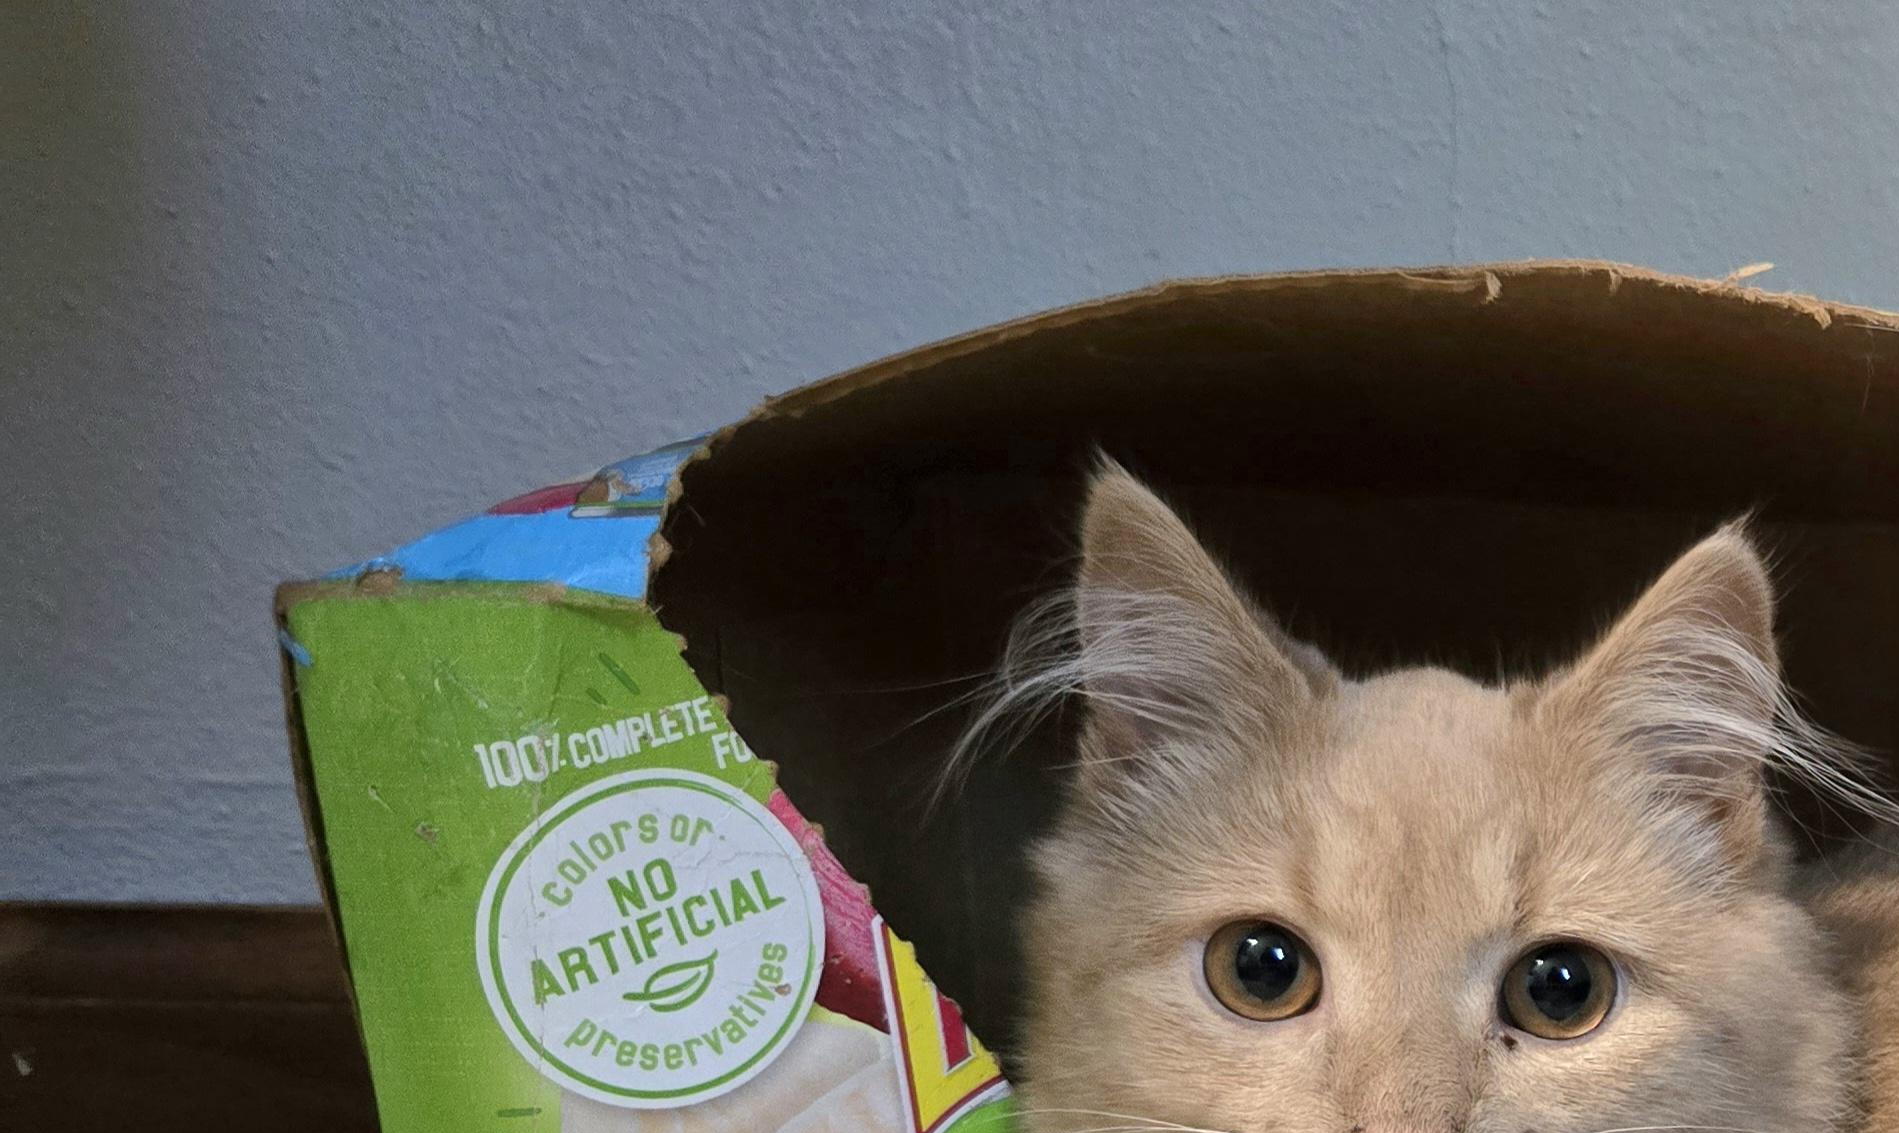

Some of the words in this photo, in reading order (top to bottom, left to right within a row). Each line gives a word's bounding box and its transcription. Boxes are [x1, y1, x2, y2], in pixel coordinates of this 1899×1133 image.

[474, 731, 567, 789] 100%
[567, 696, 717, 769] COMPLETE
[542, 813, 659, 907] colors
[670, 813, 714, 847] or
[607, 857, 678, 917] NO
[531, 869, 787, 1006] ARTIFICIAL
[564, 942, 788, 1072] preservatives
